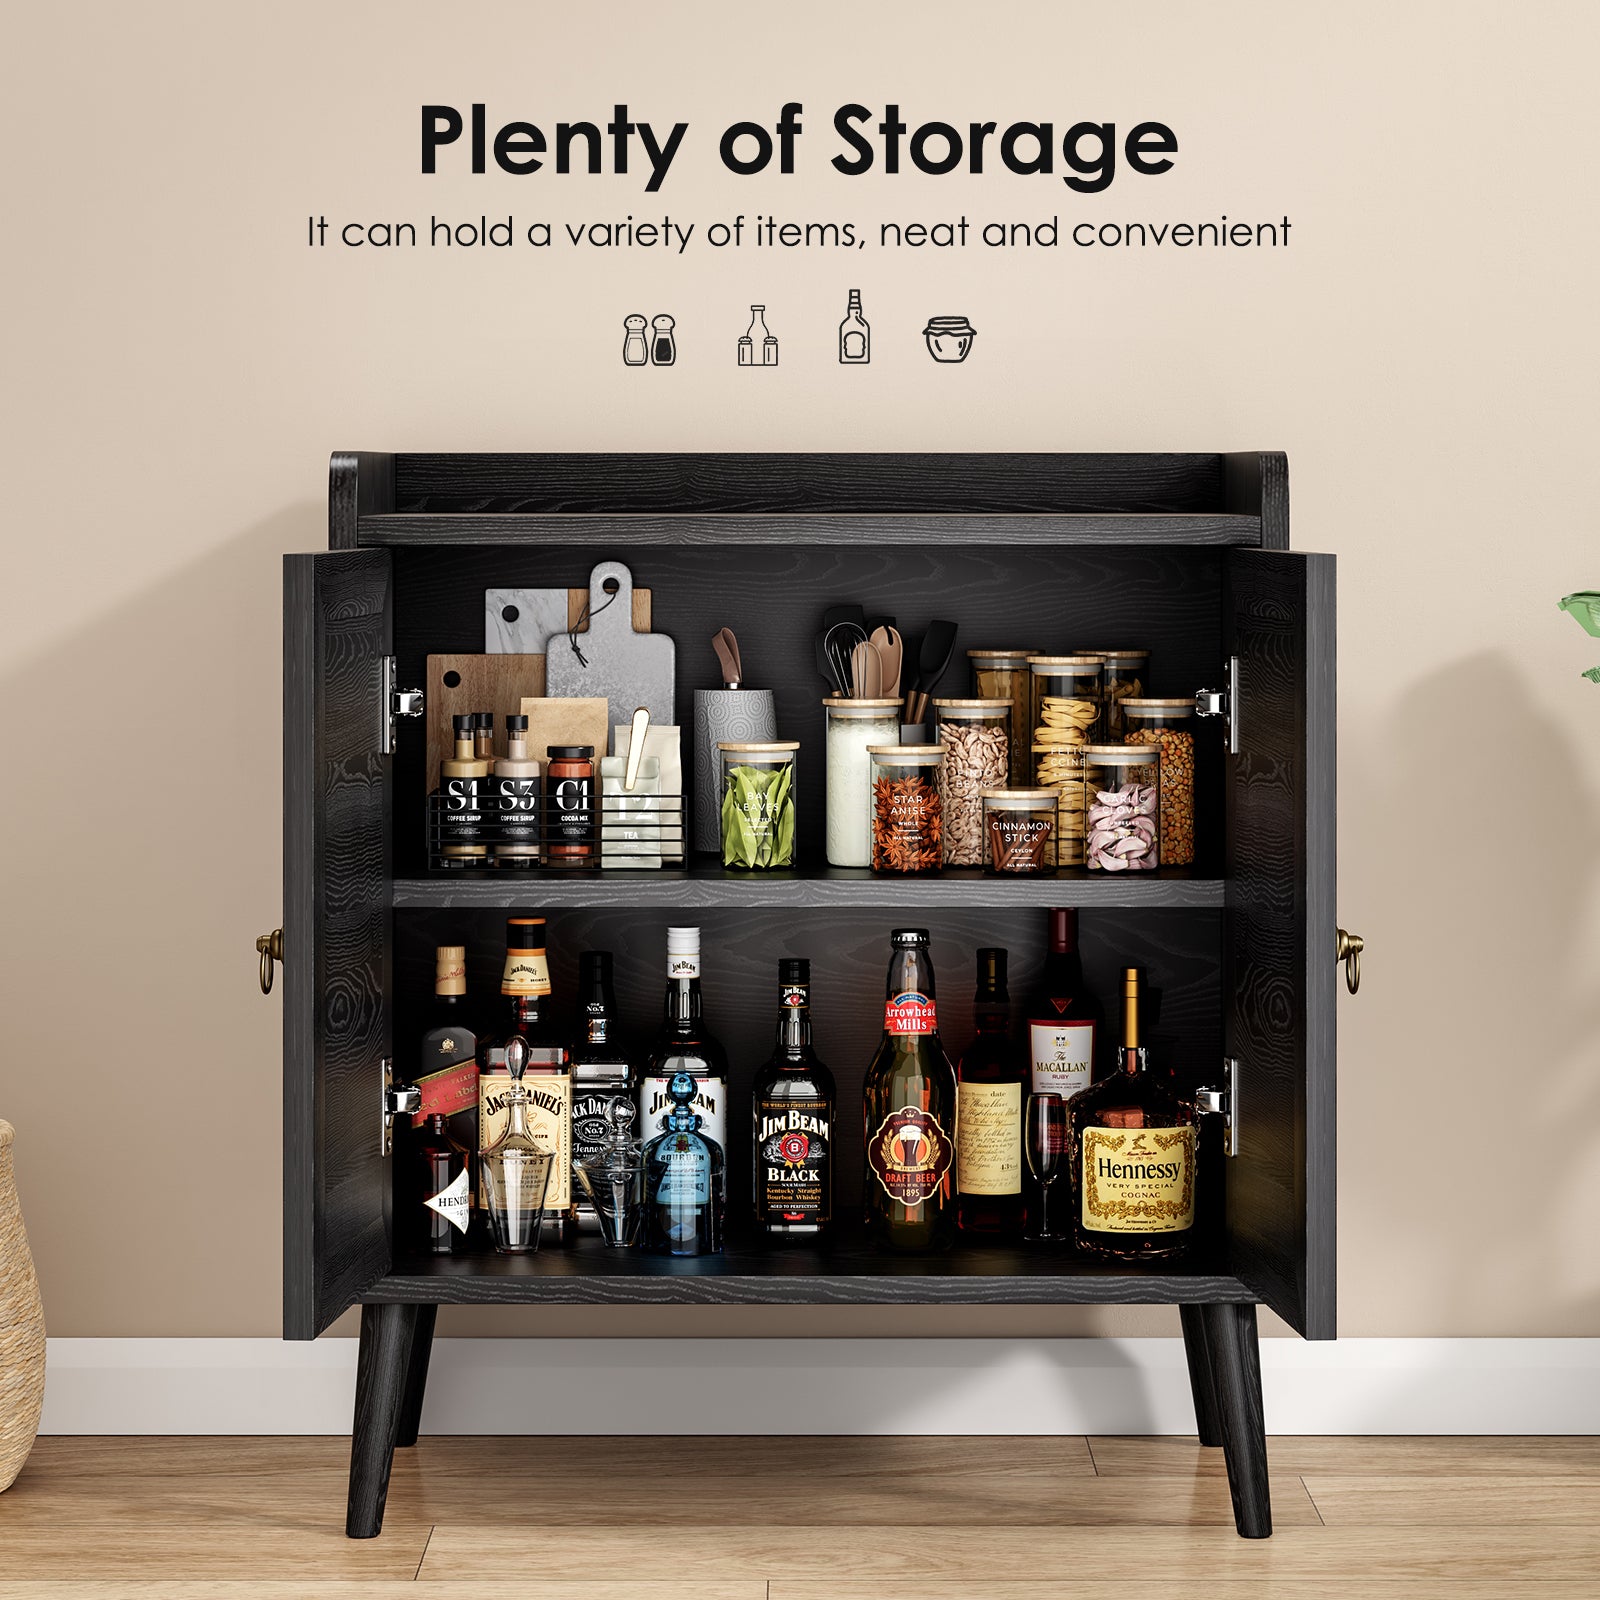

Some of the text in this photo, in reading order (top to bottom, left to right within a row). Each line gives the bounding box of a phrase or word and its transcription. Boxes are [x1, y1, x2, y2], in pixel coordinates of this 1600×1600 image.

[955, 779, 994, 788] BEANS
[447, 780, 480, 811] S1
[499, 780, 536, 811] S3
[556, 780, 590, 811] C1
[747, 791, 770, 801] BAY
[893, 795, 924, 804] STAR
[738, 802, 779, 812] LEAVES
[890, 806, 927, 815] ANISE
[1102, 806, 1147, 815] CLOVES
[992, 822, 1051, 831] CINNAMON
[624, 831, 640, 840] TEA
[1005, 833, 1039, 842] STICK
[886, 1005, 936, 1018] Arrowhead
[896, 1018, 927, 1031] Mills
[1053, 1051, 1067, 1062] The
[1036, 1061, 1087, 1073] MACALLAN
[758, 1110, 829, 1142] JIM BEAM
[790, 1143, 799, 1153] B
[767, 1166, 820, 1182] BLACK
[1098, 1157, 1182, 1182] Hennessy
[885, 1172, 936, 1183] DRAFT BEER
[902, 1188, 920, 1197] 1895
[1121, 1191, 1161, 1199] COGNAC
